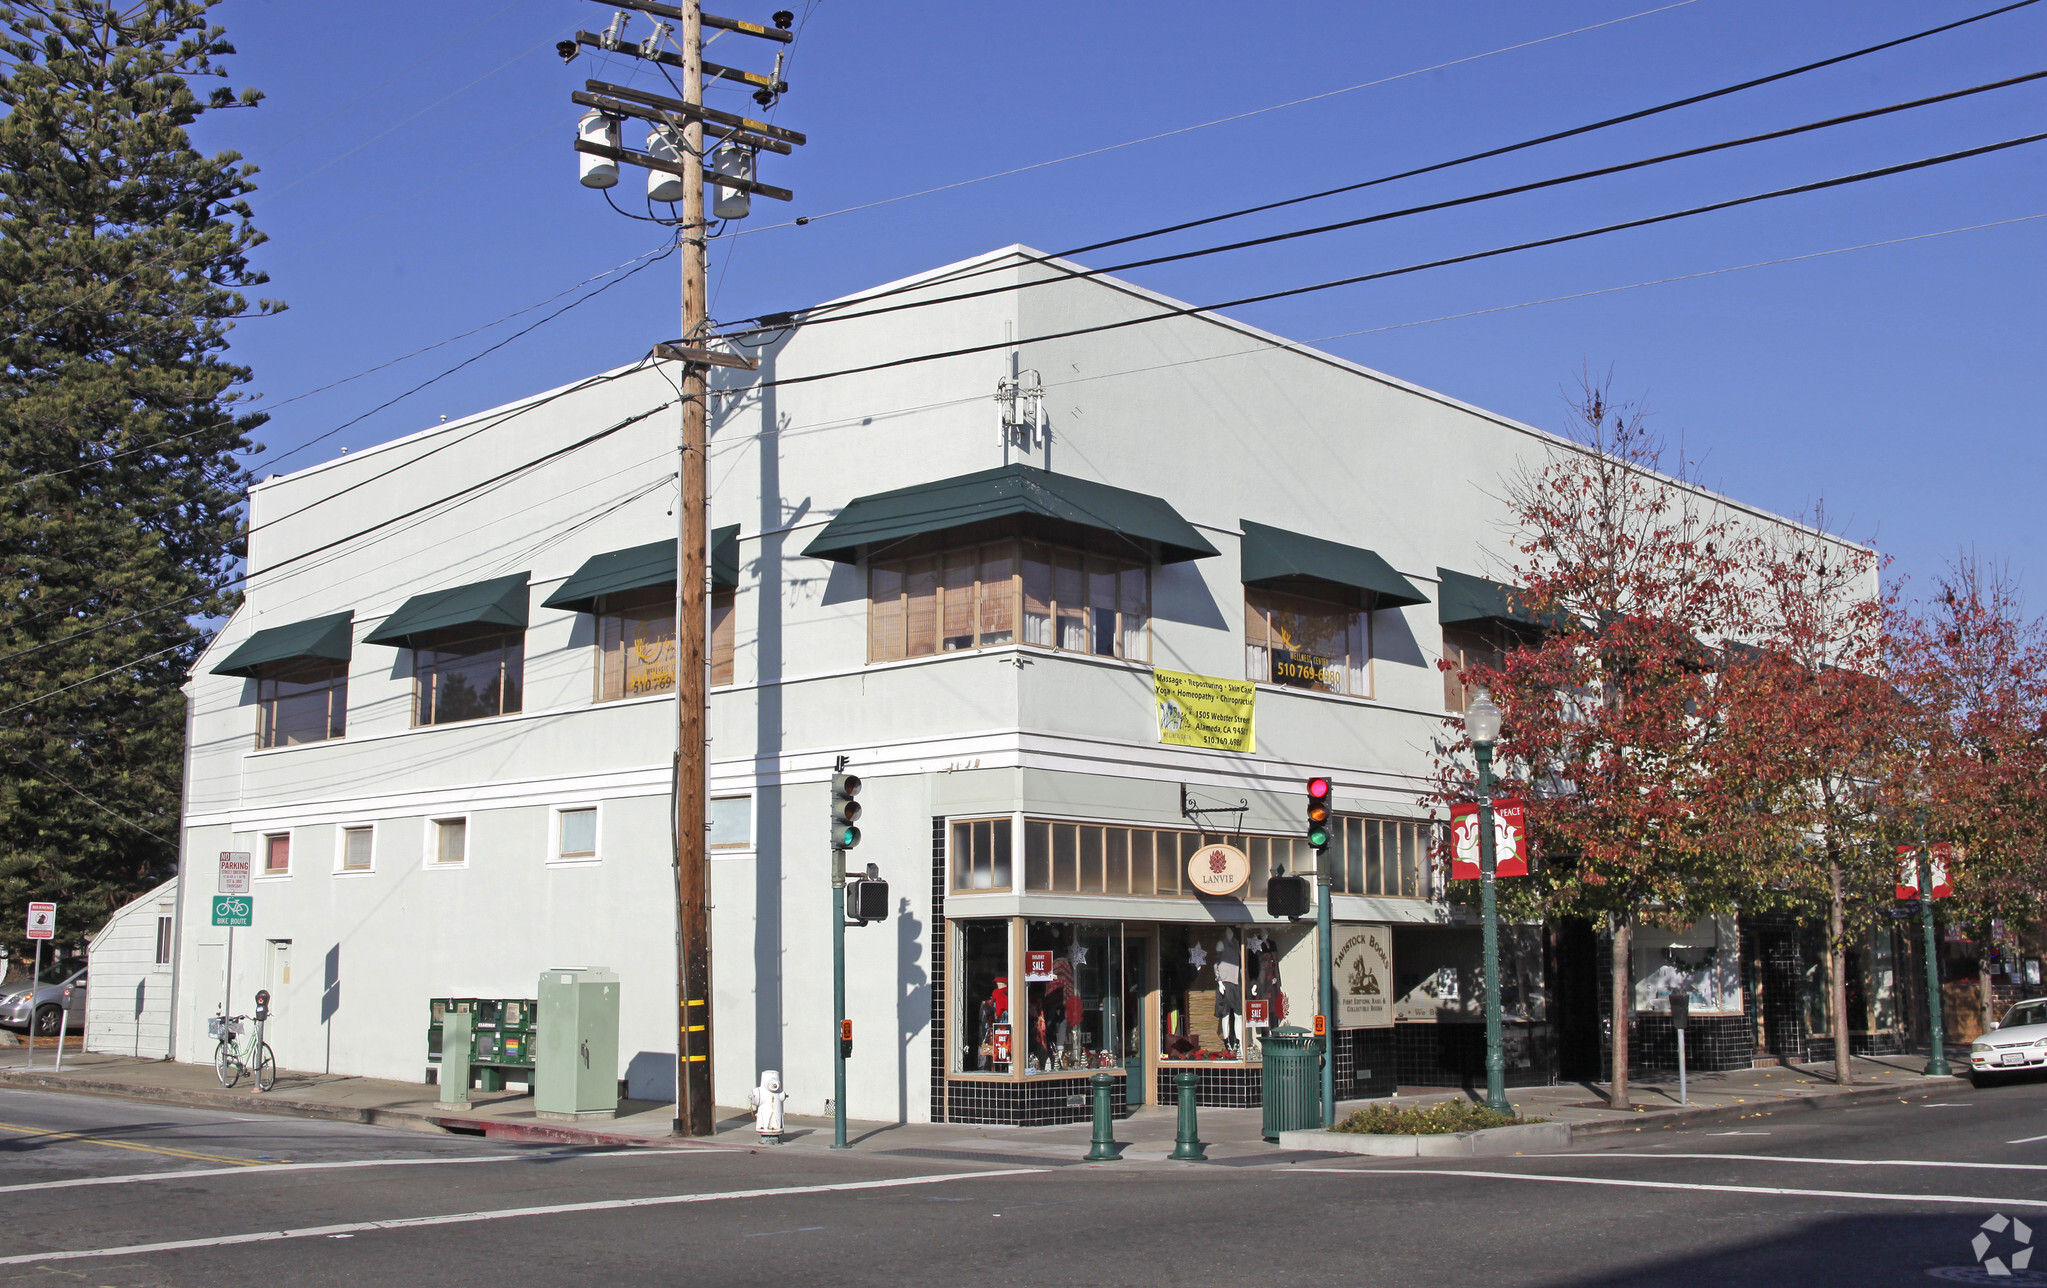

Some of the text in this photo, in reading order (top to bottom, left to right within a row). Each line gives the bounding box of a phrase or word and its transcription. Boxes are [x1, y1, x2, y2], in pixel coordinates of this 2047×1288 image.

[1278, 662, 1341, 684] 510 769-6980
[1156, 674, 1253, 694] Massage Reposturing Skin Care
[1155, 686, 1253, 706] Yoga Homeopathy Chiropractic
[1195, 711, 1210, 719] 1505
[1211, 713, 1233, 723] Webster
[1194, 723, 1222, 734] Alameda,
[1223, 726, 1232, 734] CA
[1500, 807, 1521, 817] PEACE
[220, 853, 230, 861] NO
[221, 862, 249, 870] PARKING
[1203, 875, 1234, 884] LANVIE
[1334, 934, 1389, 970] TAVISTOCK BOOKS
[1032, 961, 1045, 970] SALE
[1251, 1009, 1262, 1018] SALE
